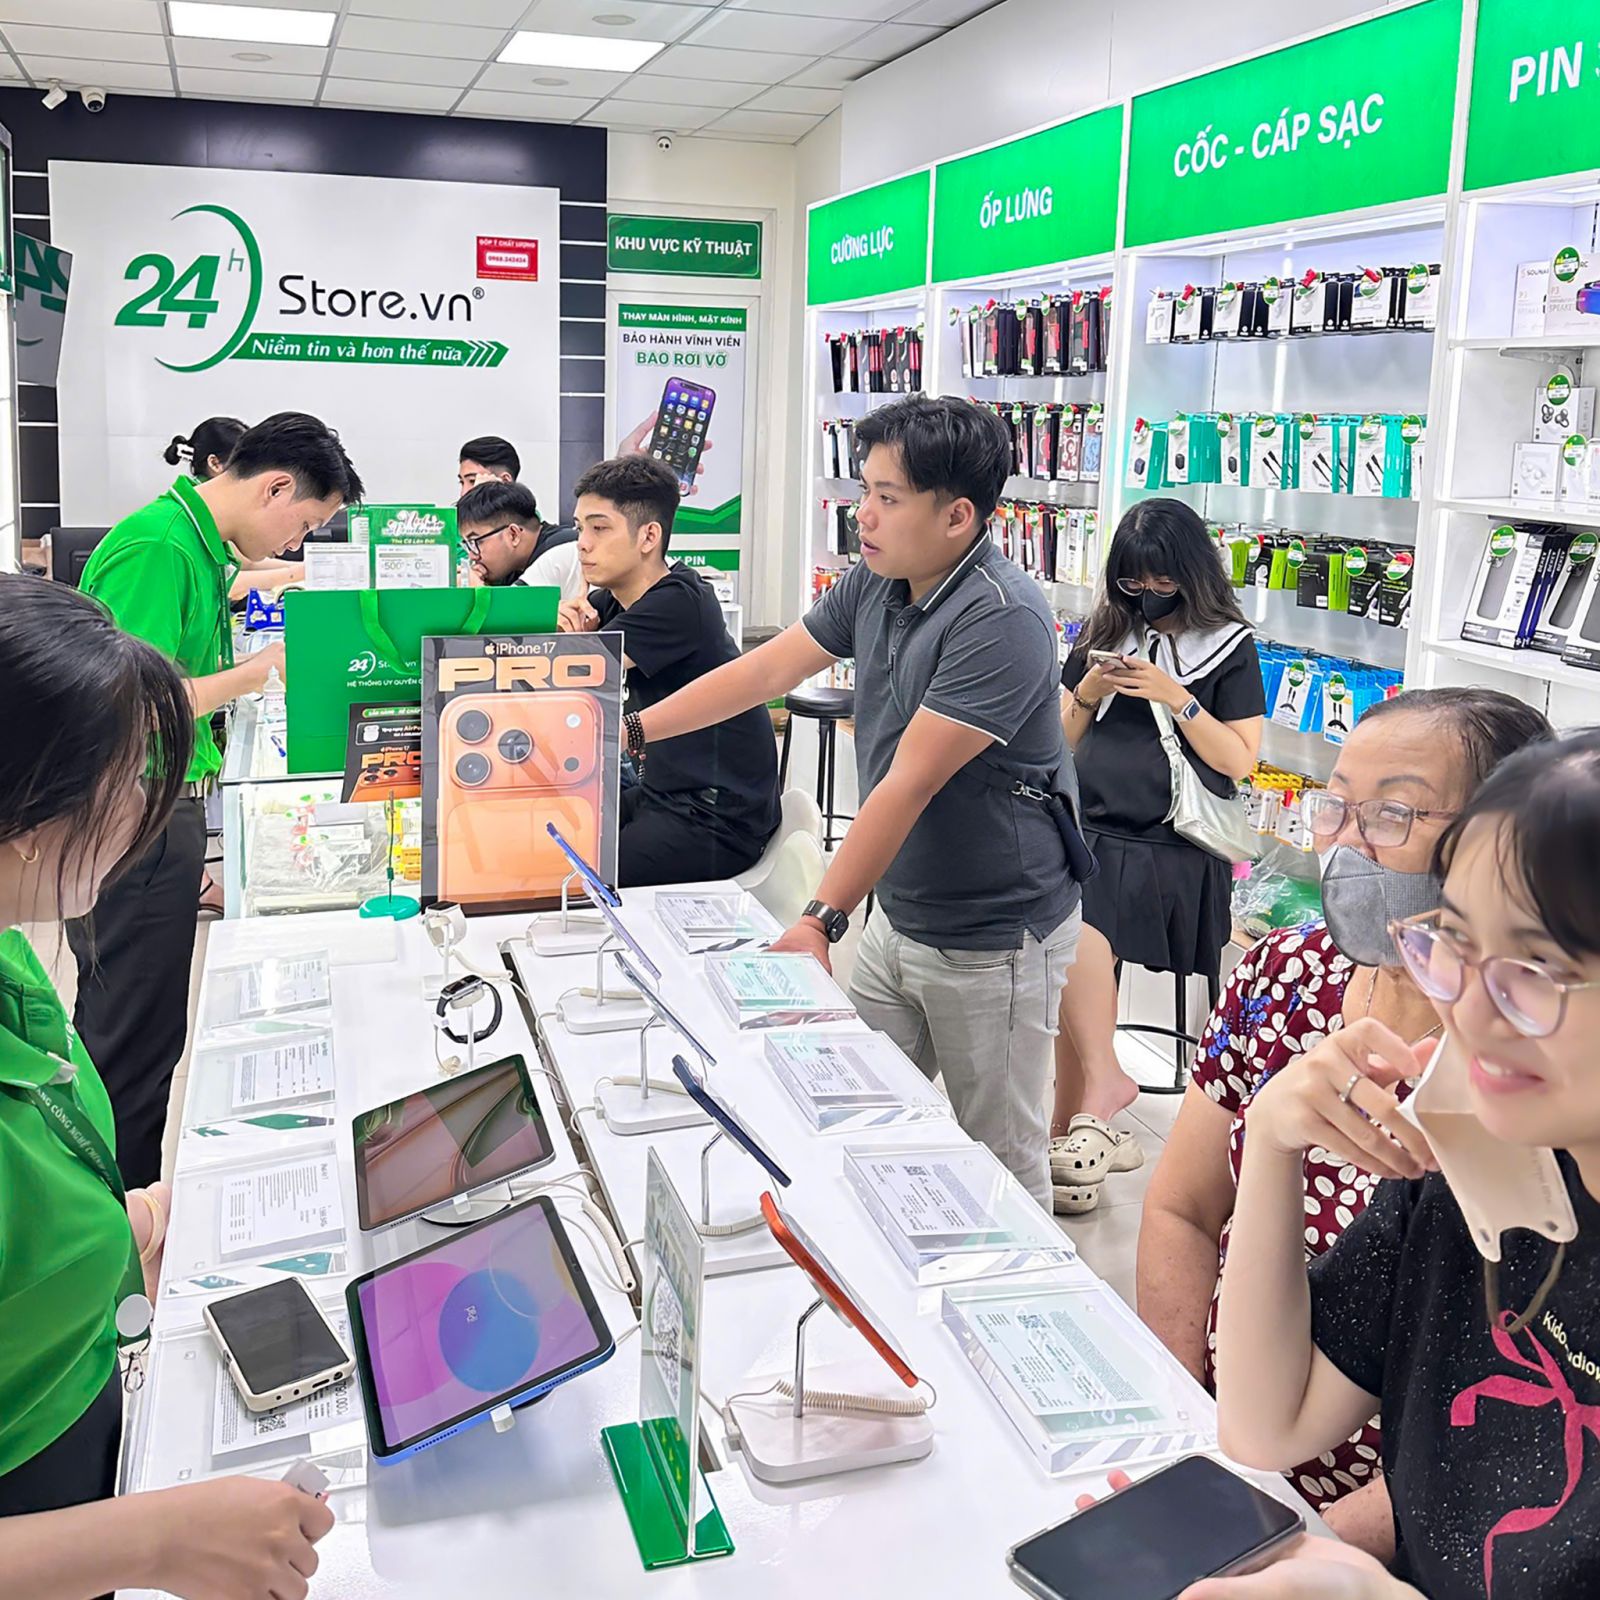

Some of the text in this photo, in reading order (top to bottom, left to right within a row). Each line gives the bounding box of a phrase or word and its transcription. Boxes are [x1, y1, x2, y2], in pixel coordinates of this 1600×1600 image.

[1509, 41, 1583, 103] PIN
[1174, 124, 1228, 177] CỐC
[1252, 106, 1311, 159] CÁP
[1317, 93, 1384, 149] SẠC
[979, 186, 1053, 229] ỐP LƯNG
[615, 236, 752, 258] KHU VỰC KỸ THUẬT
[831, 225, 894, 264] CƯỜNG LỰC
[622, 311, 646, 320] THAY
[649, 312, 670, 321] MÀN
[699, 314, 719, 325] MẶT
[720, 315, 742, 325] KÍNH
[252, 336, 462, 361] Niềm tin và hơn thế nữa
[623, 331, 646, 343] BẢO
[650, 333, 682, 345] HÀNH
[685, 334, 712, 346] VĨNH
[637, 351, 727, 366] BAO RƠI VỠ
[684, 556, 706, 566] PIN
[495, 641, 557, 655] iPhone 17
[438, 654, 606, 692] PRO
